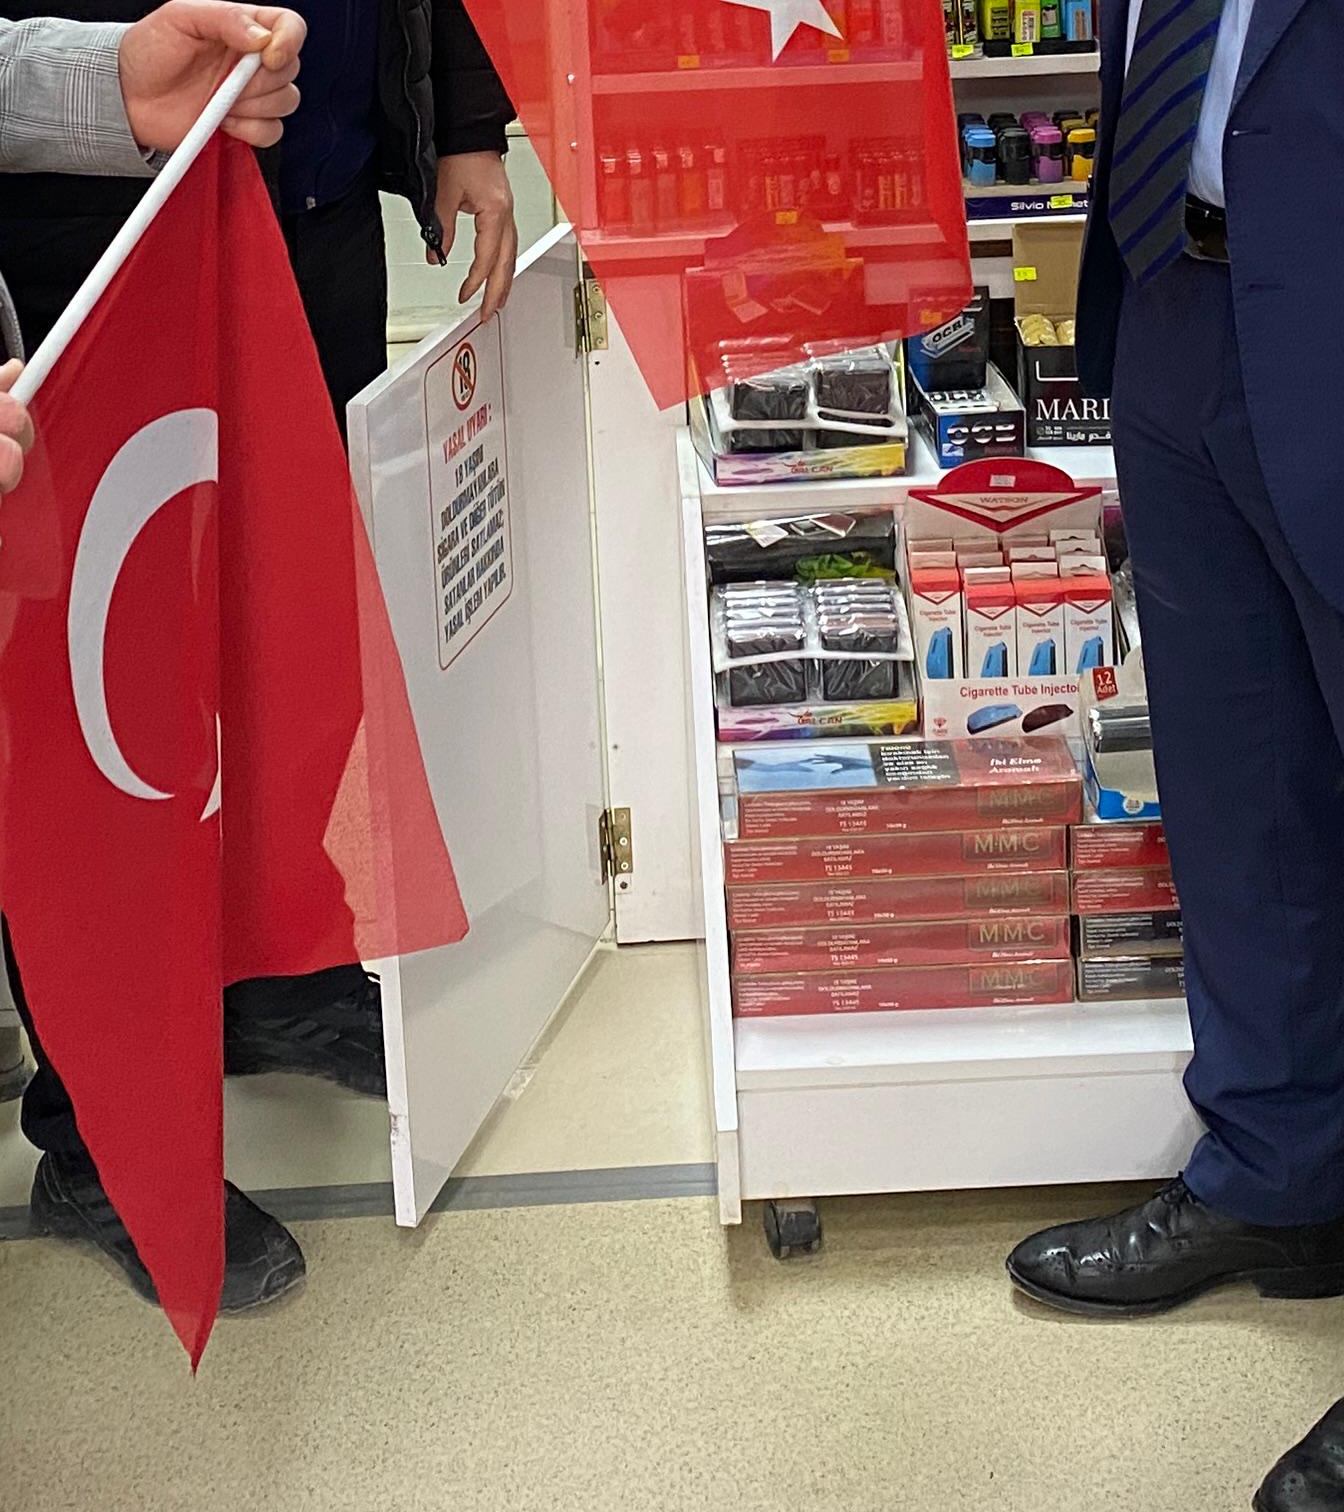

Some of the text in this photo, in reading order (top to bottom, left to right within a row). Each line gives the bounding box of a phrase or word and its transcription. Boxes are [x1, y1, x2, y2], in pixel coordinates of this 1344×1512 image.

[1011, 202, 1044, 211] Silvio
[1036, 398, 1111, 421] MARI
[442, 425, 466, 464] YASAL
[455, 467, 462, 488] 18
[980, 497, 1029, 505] WATSON
[437, 525, 459, 564] SİGARA
[460, 518, 468, 539] VE
[444, 563, 476, 615] SATANLAR
[443, 608, 464, 643] YASAL
[1097, 673, 1112, 684] 12
[960, 687, 1009, 699] Cigarette
[1012, 686, 1038, 696] Tube
